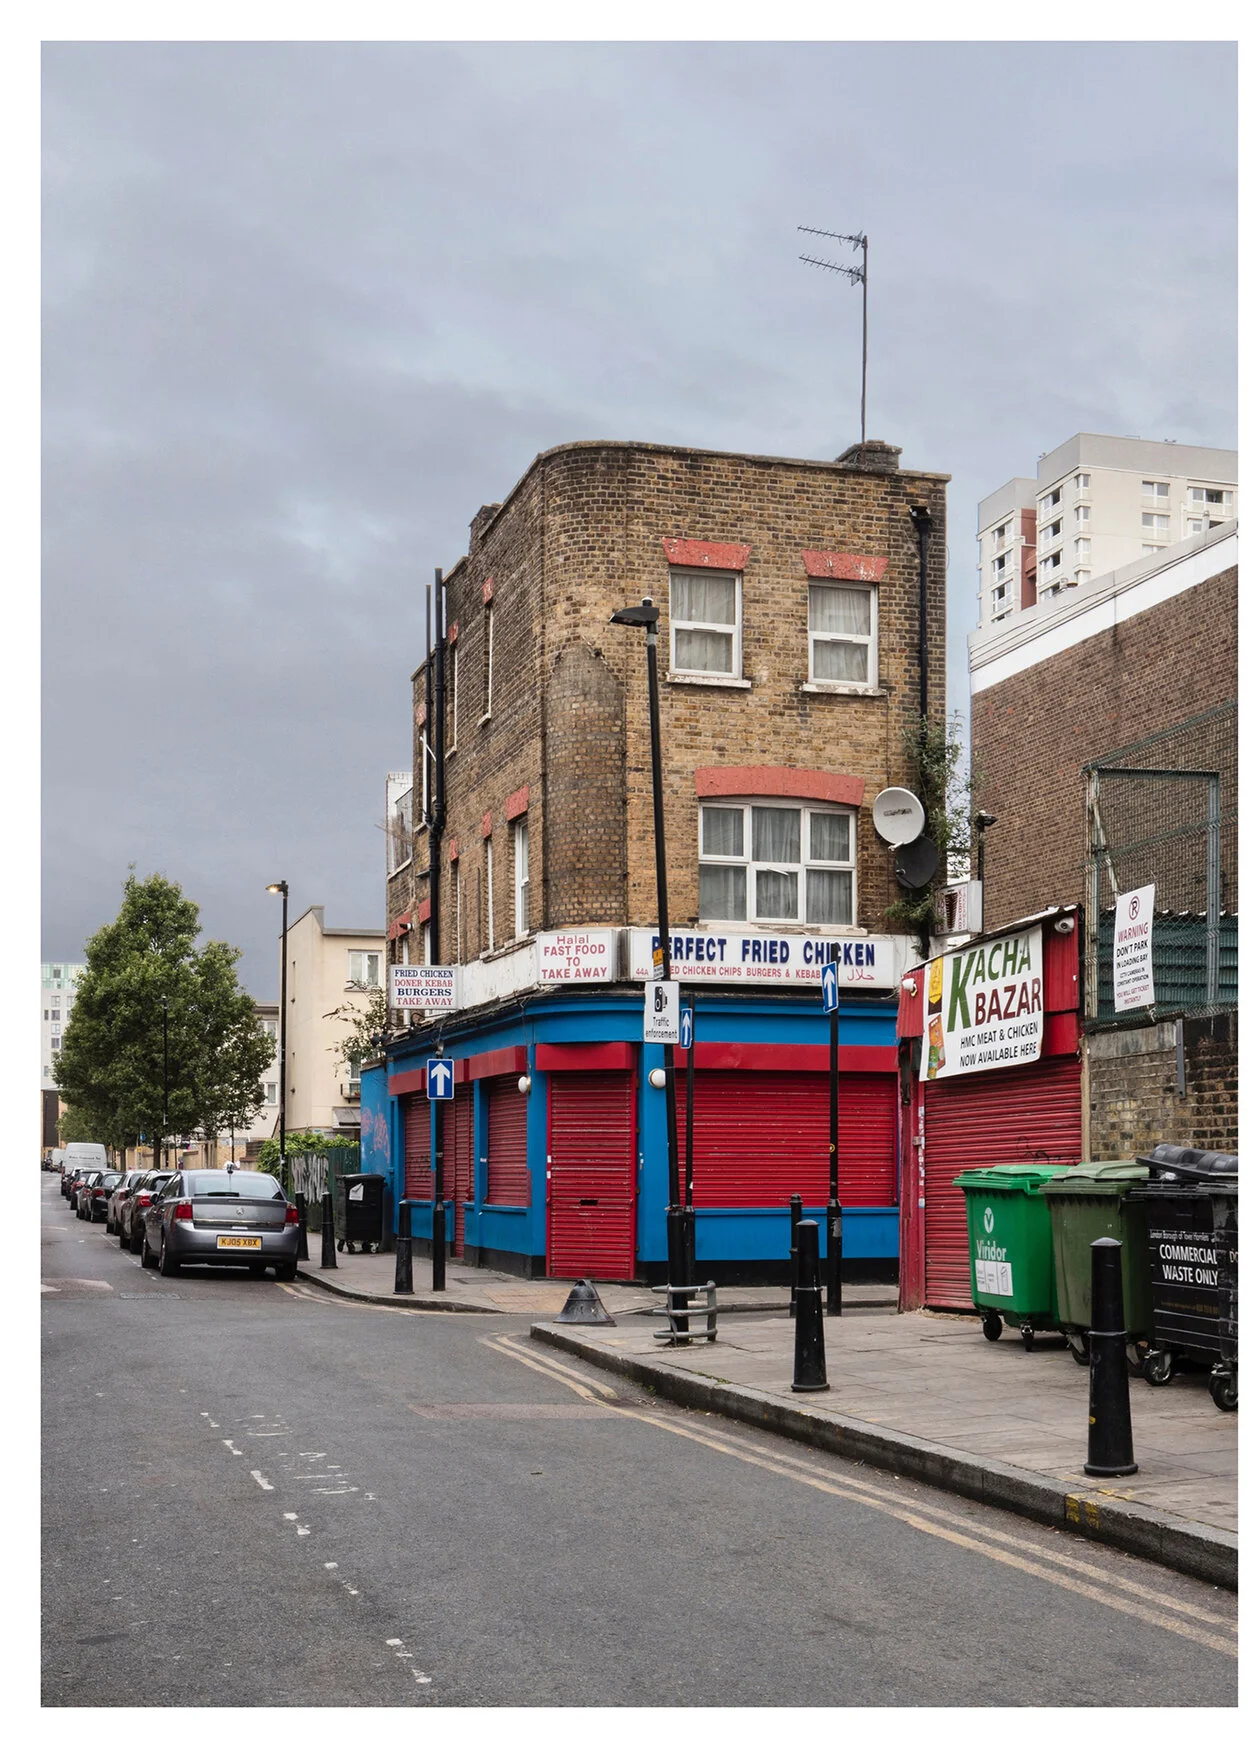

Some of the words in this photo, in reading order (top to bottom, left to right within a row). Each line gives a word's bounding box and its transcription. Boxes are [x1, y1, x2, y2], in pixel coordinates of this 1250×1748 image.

[1118, 922, 1149, 943] WARNING
[556, 935, 589, 945] Halal
[543, 945, 572, 956] FAST
[575, 944, 605, 955] FOOD
[742, 939, 790, 964] FRIED
[1116, 944, 1133, 958] DON'T
[1134, 940, 1148, 952] PARK
[566, 957, 581, 967] TO
[1140, 953, 1148, 963] BAY
[394, 969, 419, 978] FRIED
[419, 969, 454, 978] CHICKEN
[541, 968, 570, 979] TAKE
[574, 967, 607, 978] AWAY
[682, 965, 717, 976] CHICKEN
[719, 966, 742, 977] CHIPS
[746, 967, 782, 978] BURGERS
[785, 970, 791, 978] &
[847, 969, 875, 981] حلال
[394, 979, 424, 987] DONER
[425, 979, 453, 987] KEBAB
[947, 935, 1032, 1033] KACHA
[397, 988, 452, 997] BURGERS
[396, 997, 423, 1006] TAKE
[424, 997, 453, 1006] AWAY
[975, 977, 1042, 1026] BAZAR
[653, 1017, 670, 1027] Traffic
[645, 1028, 678, 1039] enforcement
[960, 1035, 975, 1049] HMC
[977, 1031, 997, 1047] MEAT
[999, 1029, 1005, 1041] &
[1007, 1021, 1038, 1040] CHICKEN
[960, 1053, 976, 1068] NOW
[978, 1045, 1018, 1064] AVAILABLE
[1020, 1042, 1037, 1057] HERE
[976, 1239, 1007, 1262] Viridor
[1159, 1244, 1218, 1265] COMMERCIAL
[1162, 1264, 1194, 1282] WASTE
[1195, 1268, 1219, 1286] ONLY
